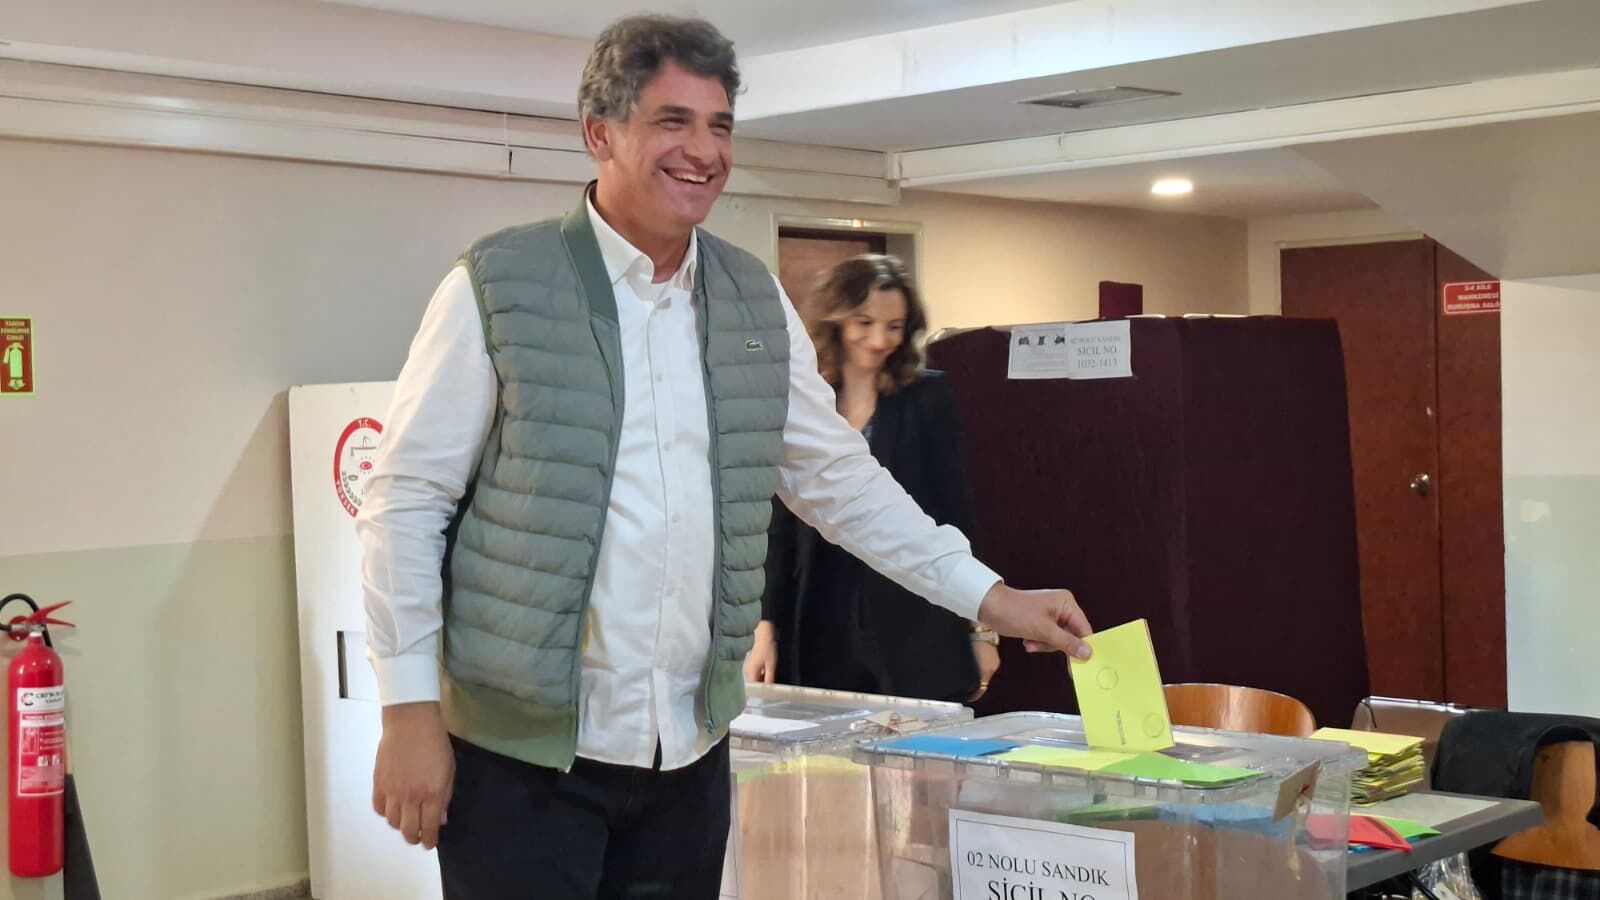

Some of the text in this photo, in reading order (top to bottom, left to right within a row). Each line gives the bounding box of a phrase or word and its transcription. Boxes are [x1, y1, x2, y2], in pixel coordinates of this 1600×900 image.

[967, 850, 1110, 886] 02 NOLU SANDIK
